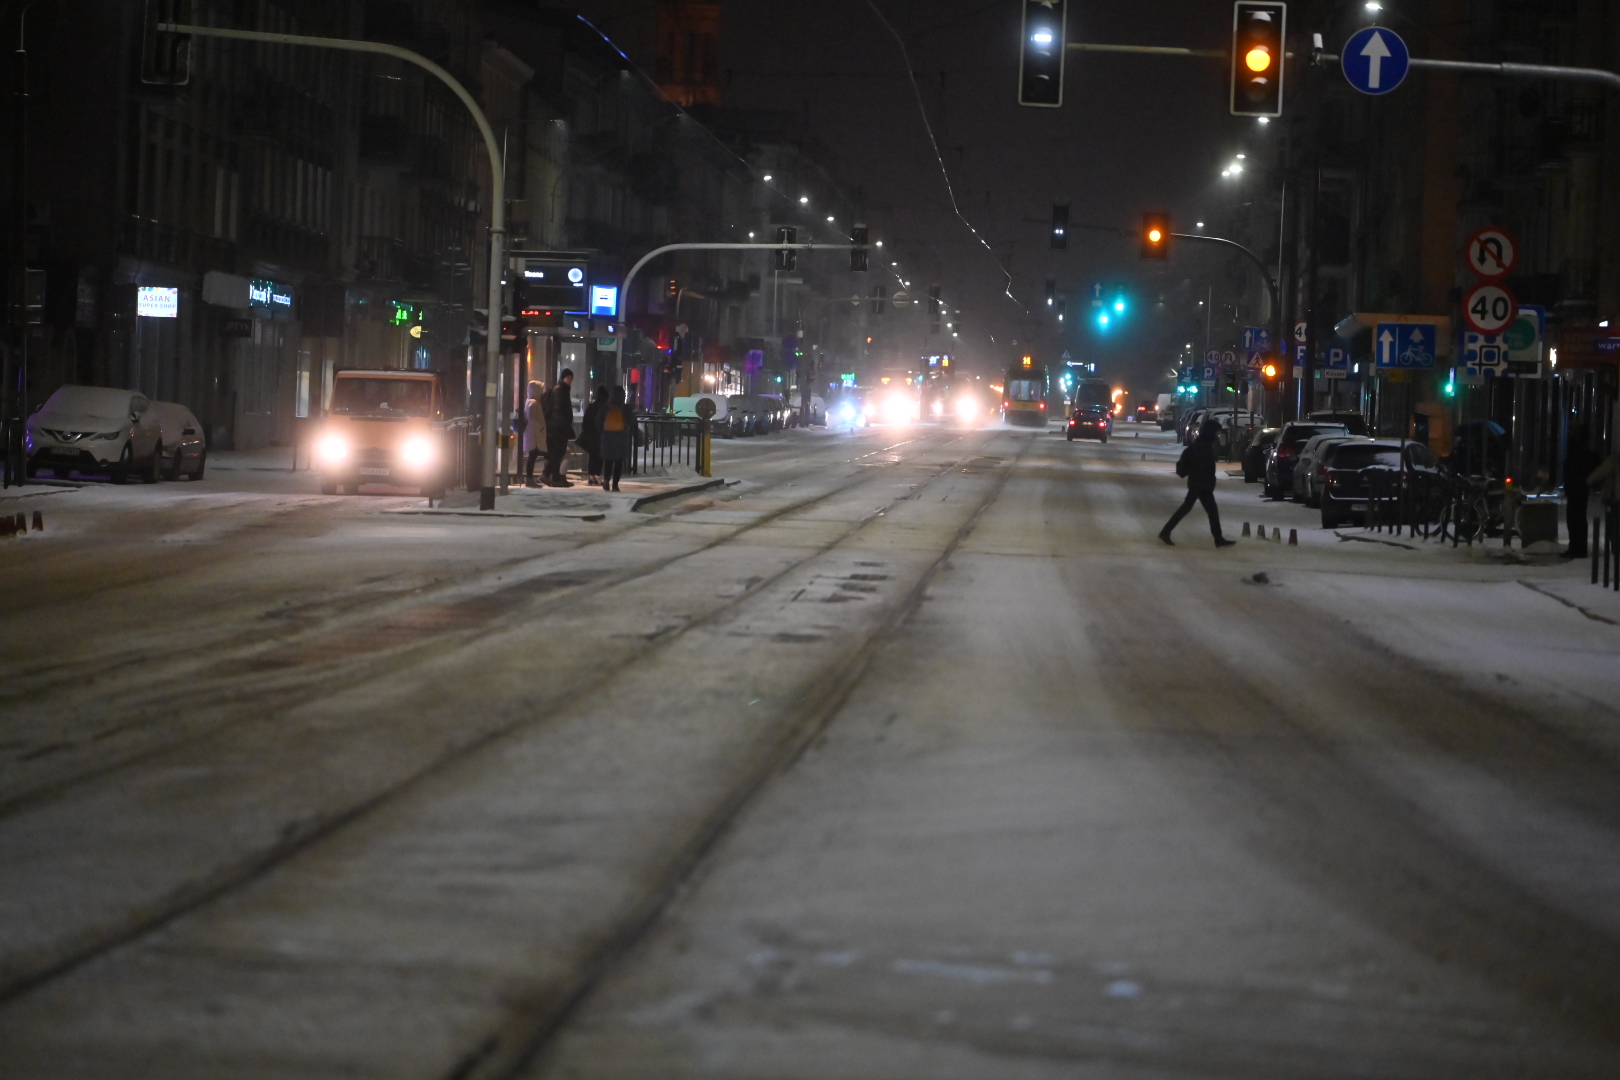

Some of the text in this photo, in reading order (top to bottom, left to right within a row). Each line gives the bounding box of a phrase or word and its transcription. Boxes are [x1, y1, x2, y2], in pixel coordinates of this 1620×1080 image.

[1471, 295, 1508, 321] 40
[1207, 353, 1219, 362] 40
[1329, 348, 1343, 366] P
[1204, 367, 1213, 379] P
